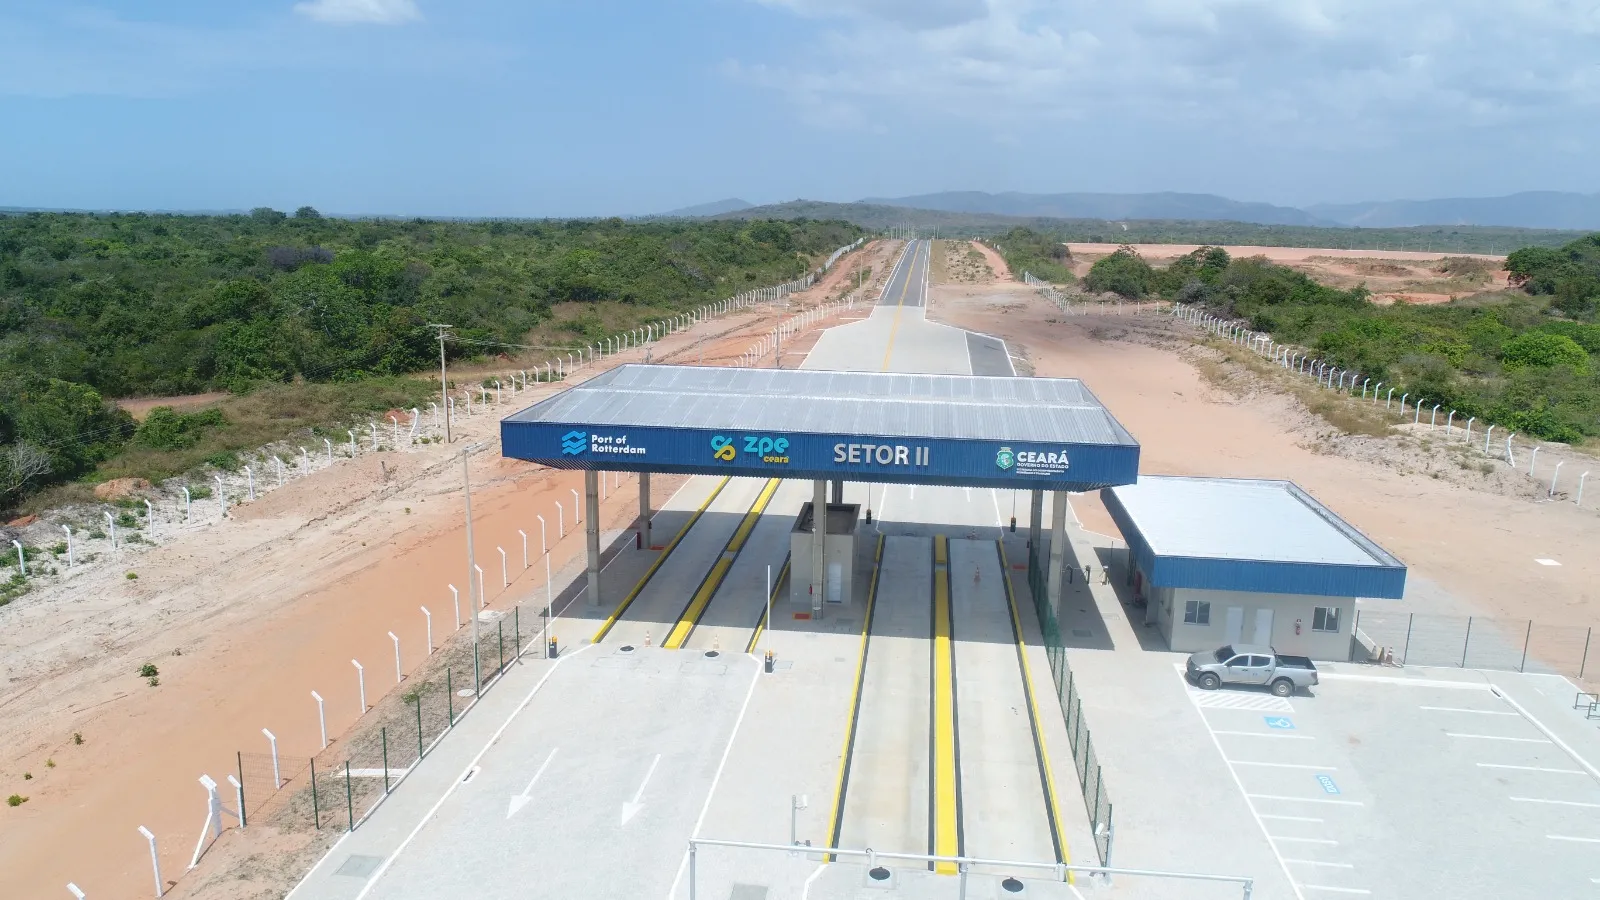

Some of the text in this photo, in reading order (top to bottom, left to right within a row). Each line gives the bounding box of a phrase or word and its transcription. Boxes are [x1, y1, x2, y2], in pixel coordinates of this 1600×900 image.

[591, 434, 627, 445] Port of
[591, 443, 646, 455] Rotterdam
[743, 436, 790, 458] zpe
[833, 443, 930, 467] SETOR II
[1017, 450, 1069, 464] CEARÁ
